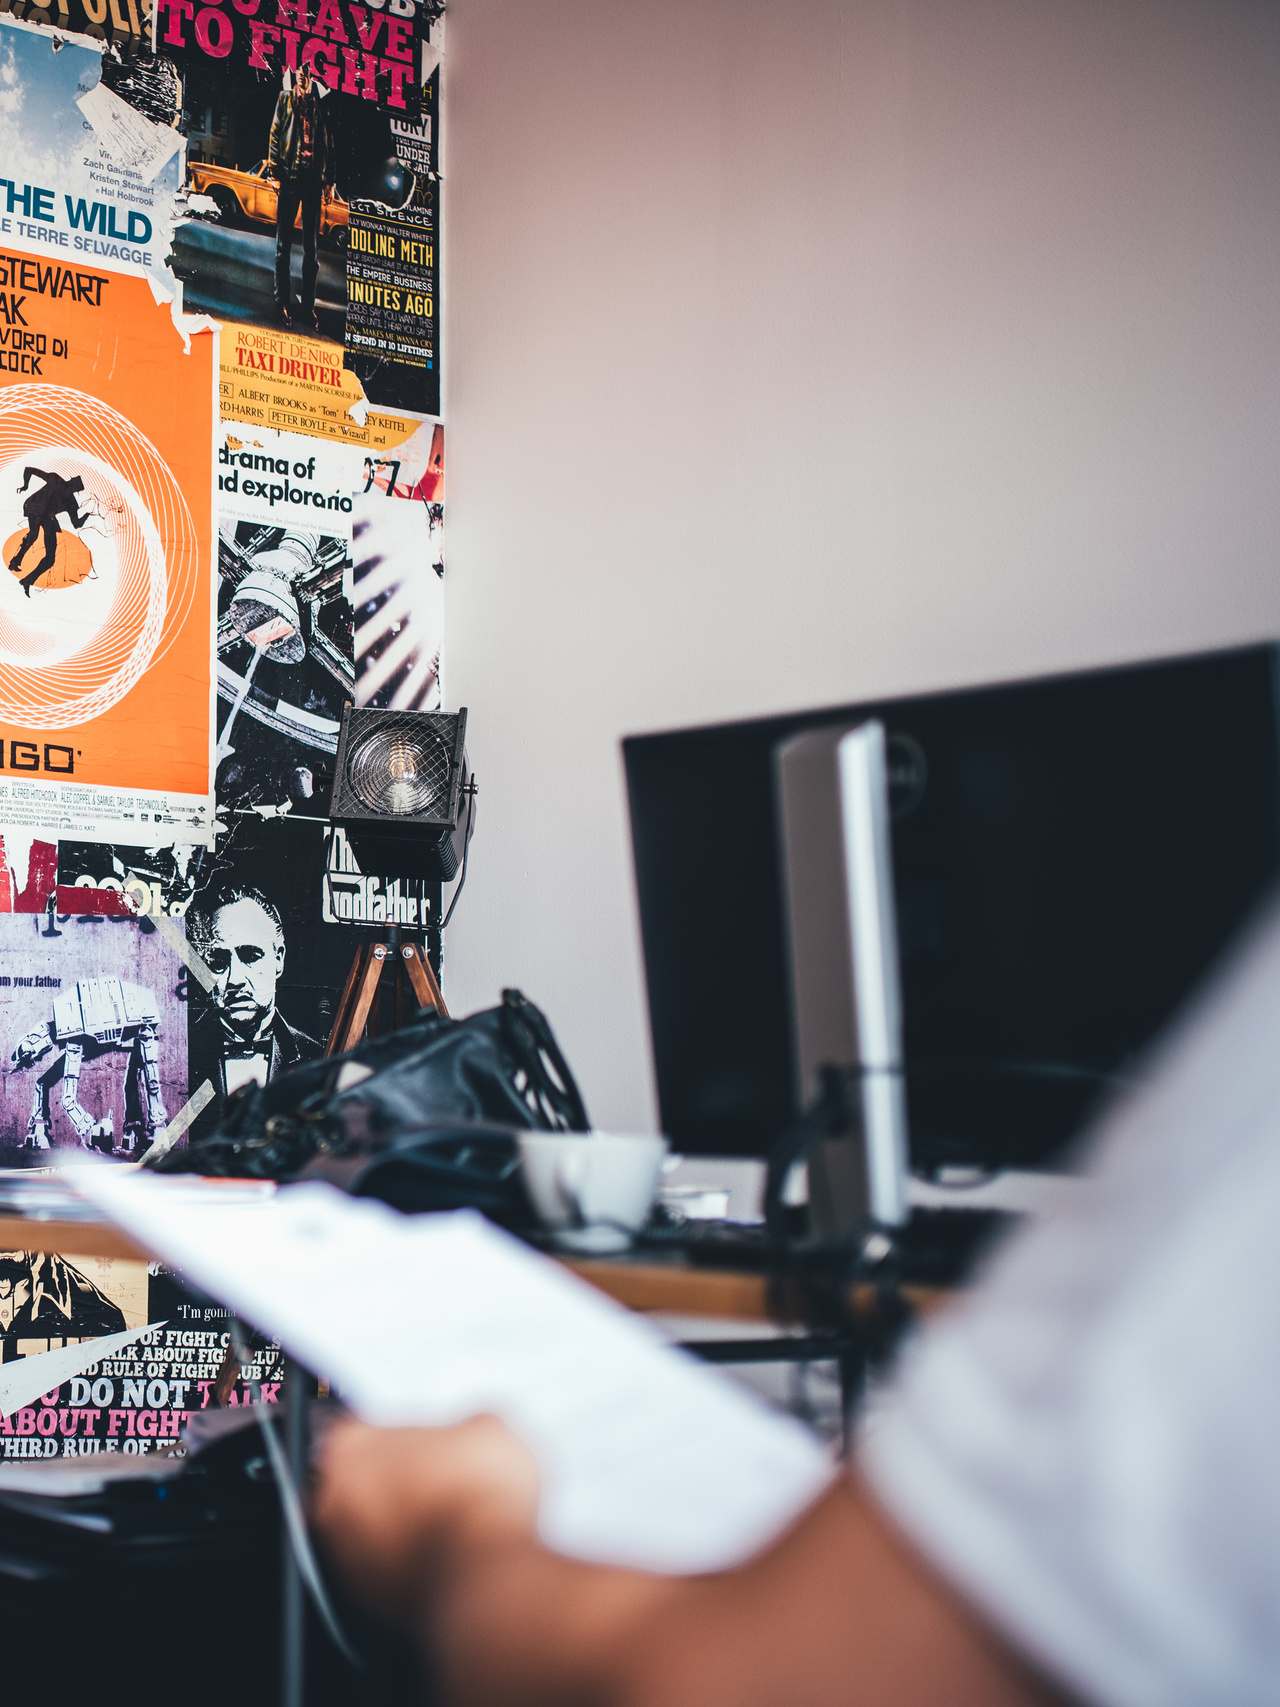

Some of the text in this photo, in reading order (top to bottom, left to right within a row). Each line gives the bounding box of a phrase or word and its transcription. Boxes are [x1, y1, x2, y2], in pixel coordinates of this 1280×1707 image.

[275, 0, 414, 63] HAVE
[248, 19, 414, 110] FIGHT
[396, 144, 431, 164] UNDER
[117, 191, 154, 207] Holbrook
[64, 194, 152, 245] WILD
[17, 221, 69, 247] TERRE
[74, 235, 152, 267] SELVAGGE
[401, 239, 433, 268] METH
[363, 268, 391, 283] EMPIRE
[394, 276, 433, 292] BUSINESS
[405, 294, 433, 318] AGO
[52, 338, 68, 360] DI
[238, 331, 286, 354] ROBERT
[235, 347, 342, 388] TAXI DRIVER
[238, 388, 307, 411] ALBERT BROOKS
[300, 382, 352, 400] MARTIN SCORSESE
[272, 411, 299, 425] PETER
[300, 417, 327, 432] BOYLE
[219, 448, 316, 479] drama of
[13, 977, 33, 988] your
[34, 975, 61, 988] father
[165, 1330, 218, 1347] FIGHT
[141, 1348, 195, 1363] ABOUT
[102, 1362, 144, 1378] RULE
[69, 1378, 190, 1408] DO NOT
